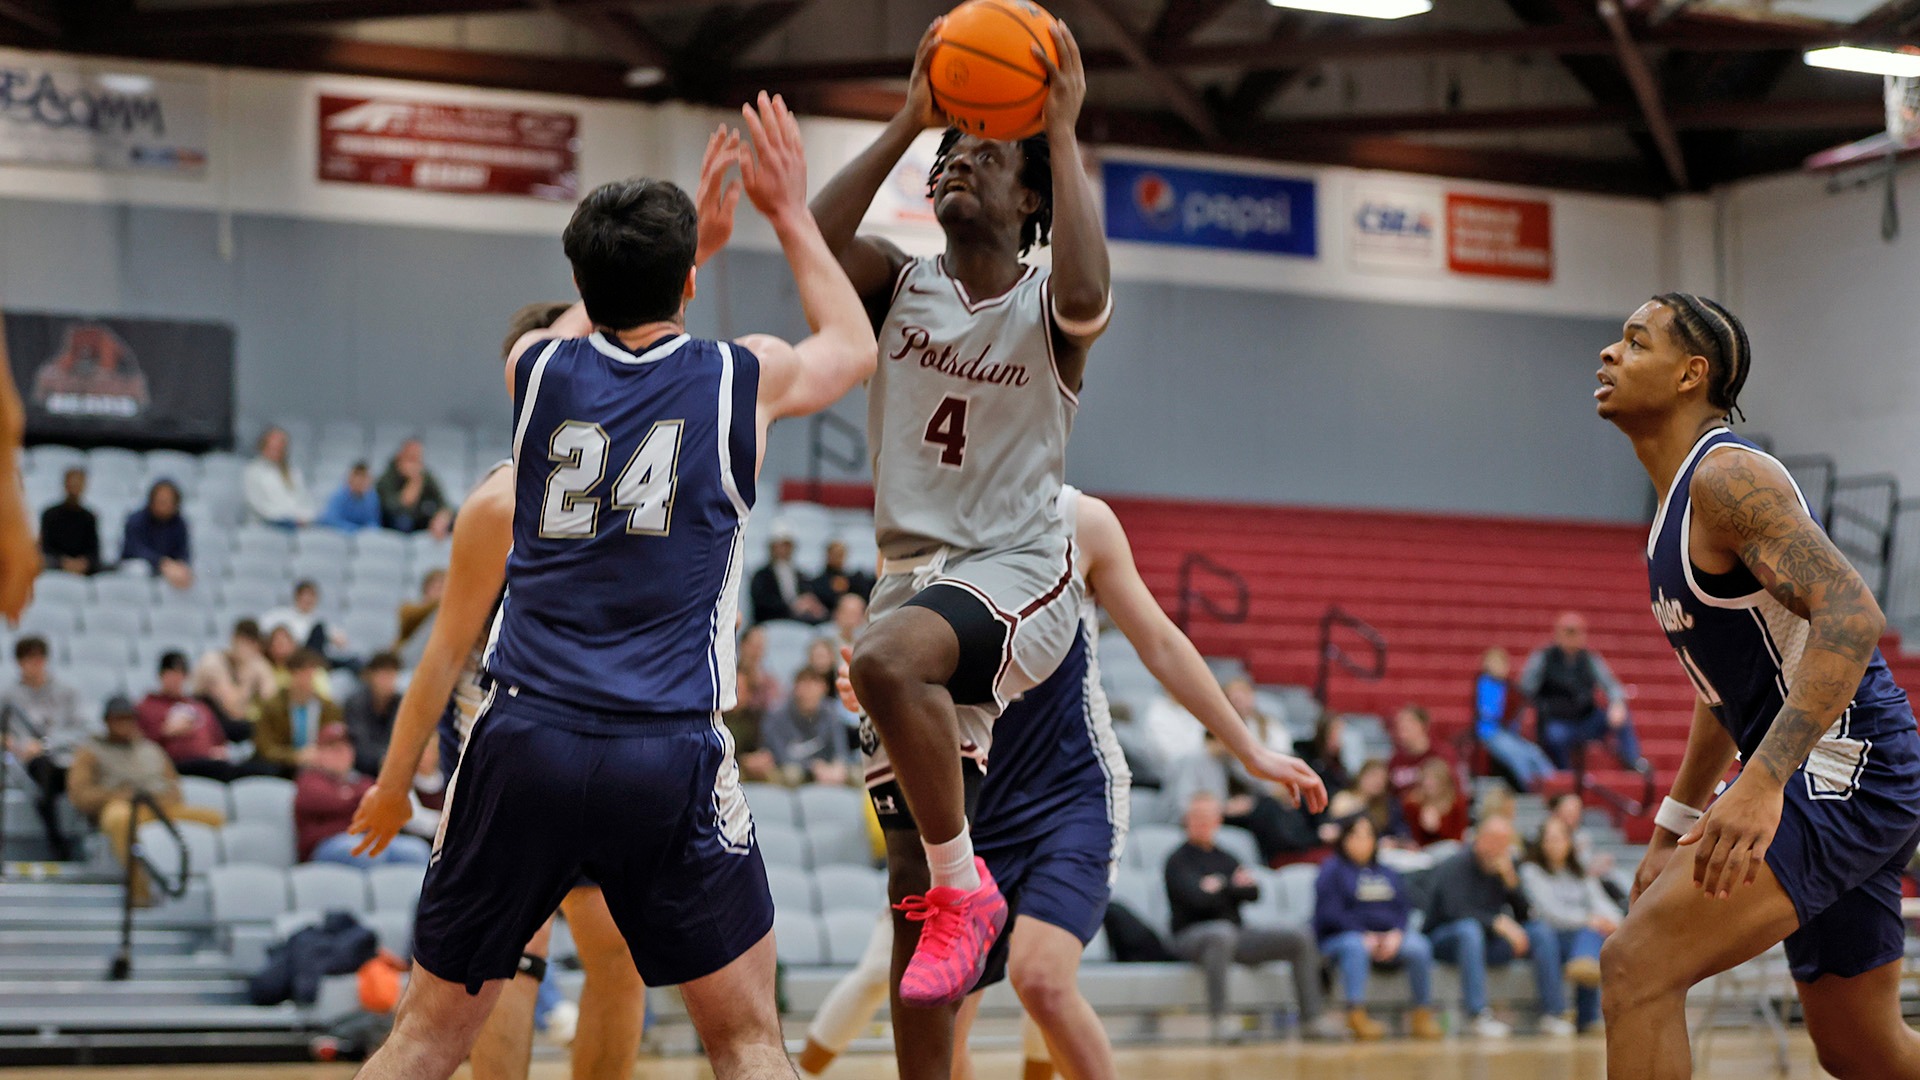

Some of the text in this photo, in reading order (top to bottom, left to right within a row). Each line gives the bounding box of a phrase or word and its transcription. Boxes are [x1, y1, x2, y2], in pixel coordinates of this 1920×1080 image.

[1182, 190, 1293, 239] pepsi
[889, 325, 1031, 387] Potsdam
[921, 392, 970, 472] 4
[538, 418, 686, 539] 24
